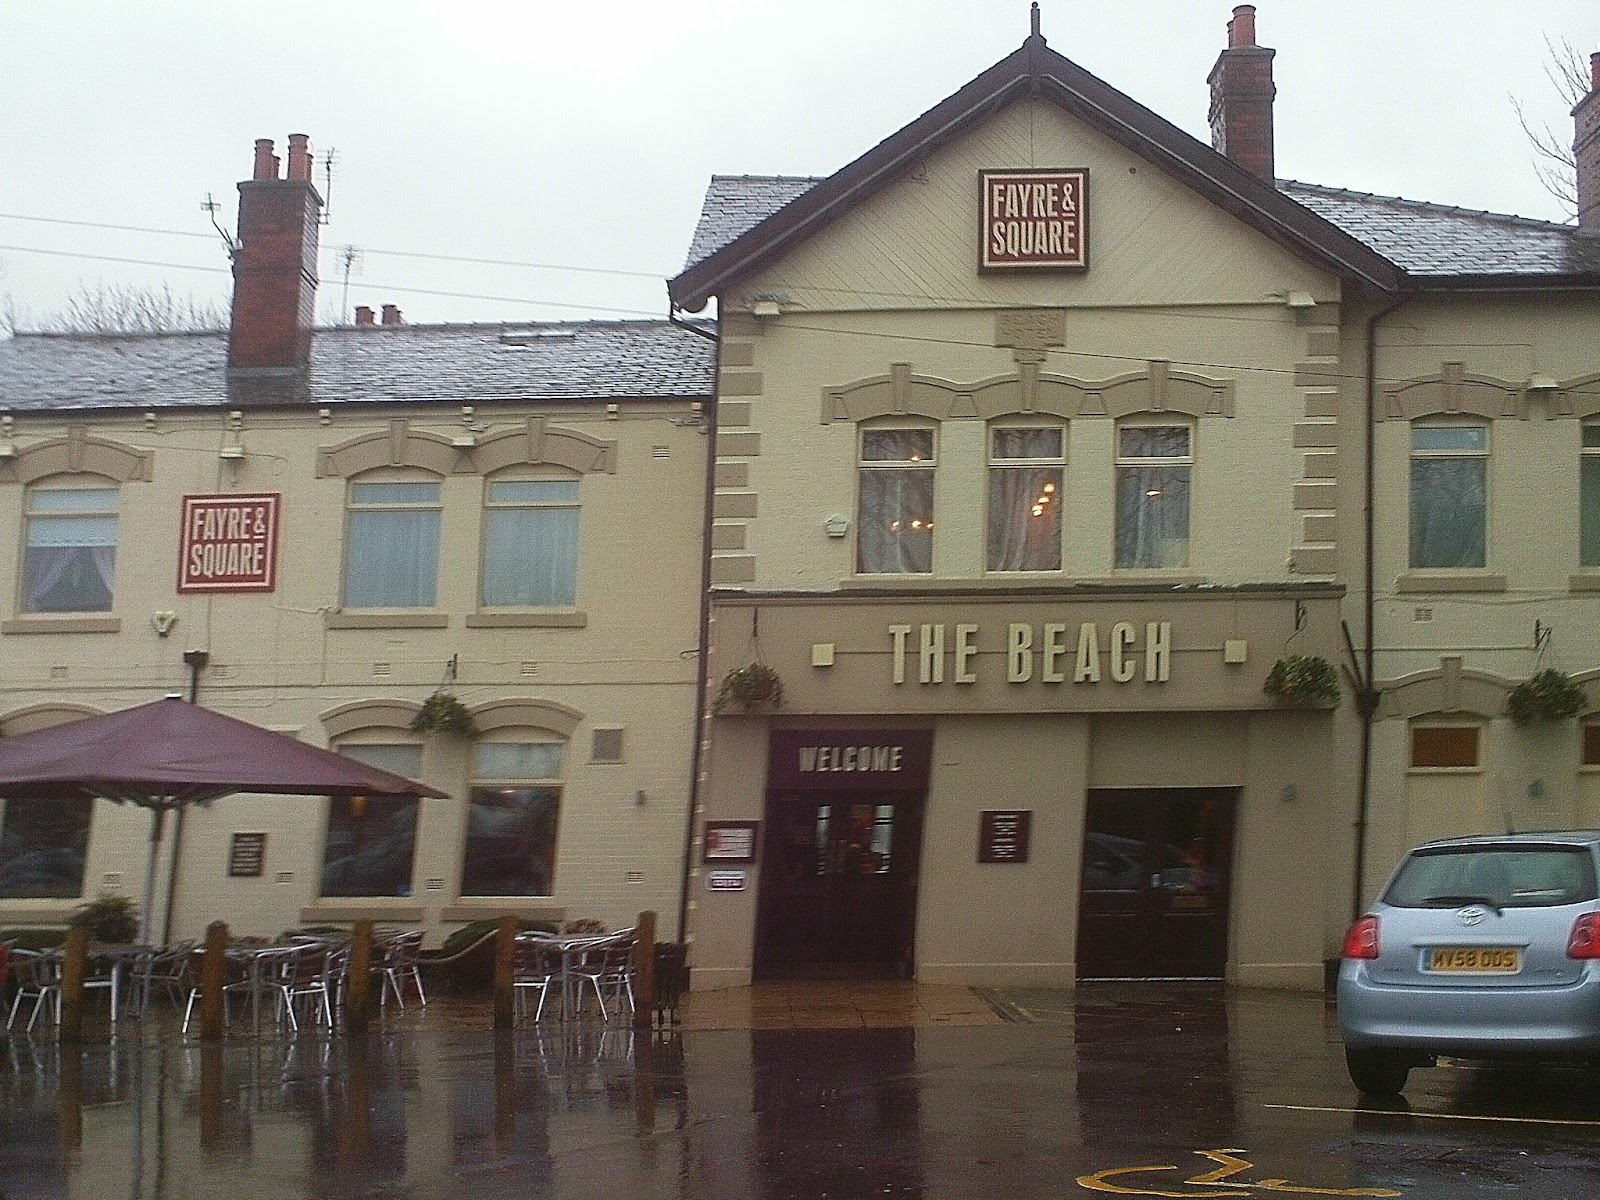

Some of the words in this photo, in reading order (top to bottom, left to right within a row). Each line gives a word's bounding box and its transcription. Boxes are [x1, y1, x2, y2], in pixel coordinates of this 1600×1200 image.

[992, 183, 1059, 218] FAYRE
[1061, 183, 1076, 217] &
[992, 220, 1076, 258] SQUARE
[192, 507, 252, 540] FAYRE
[253, 507, 266, 539] &
[189, 542, 265, 579] SQUARE
[888, 623, 978, 684] THE
[1007, 621, 1171, 683] BEACH
[799, 746, 903, 772] WELCOME
